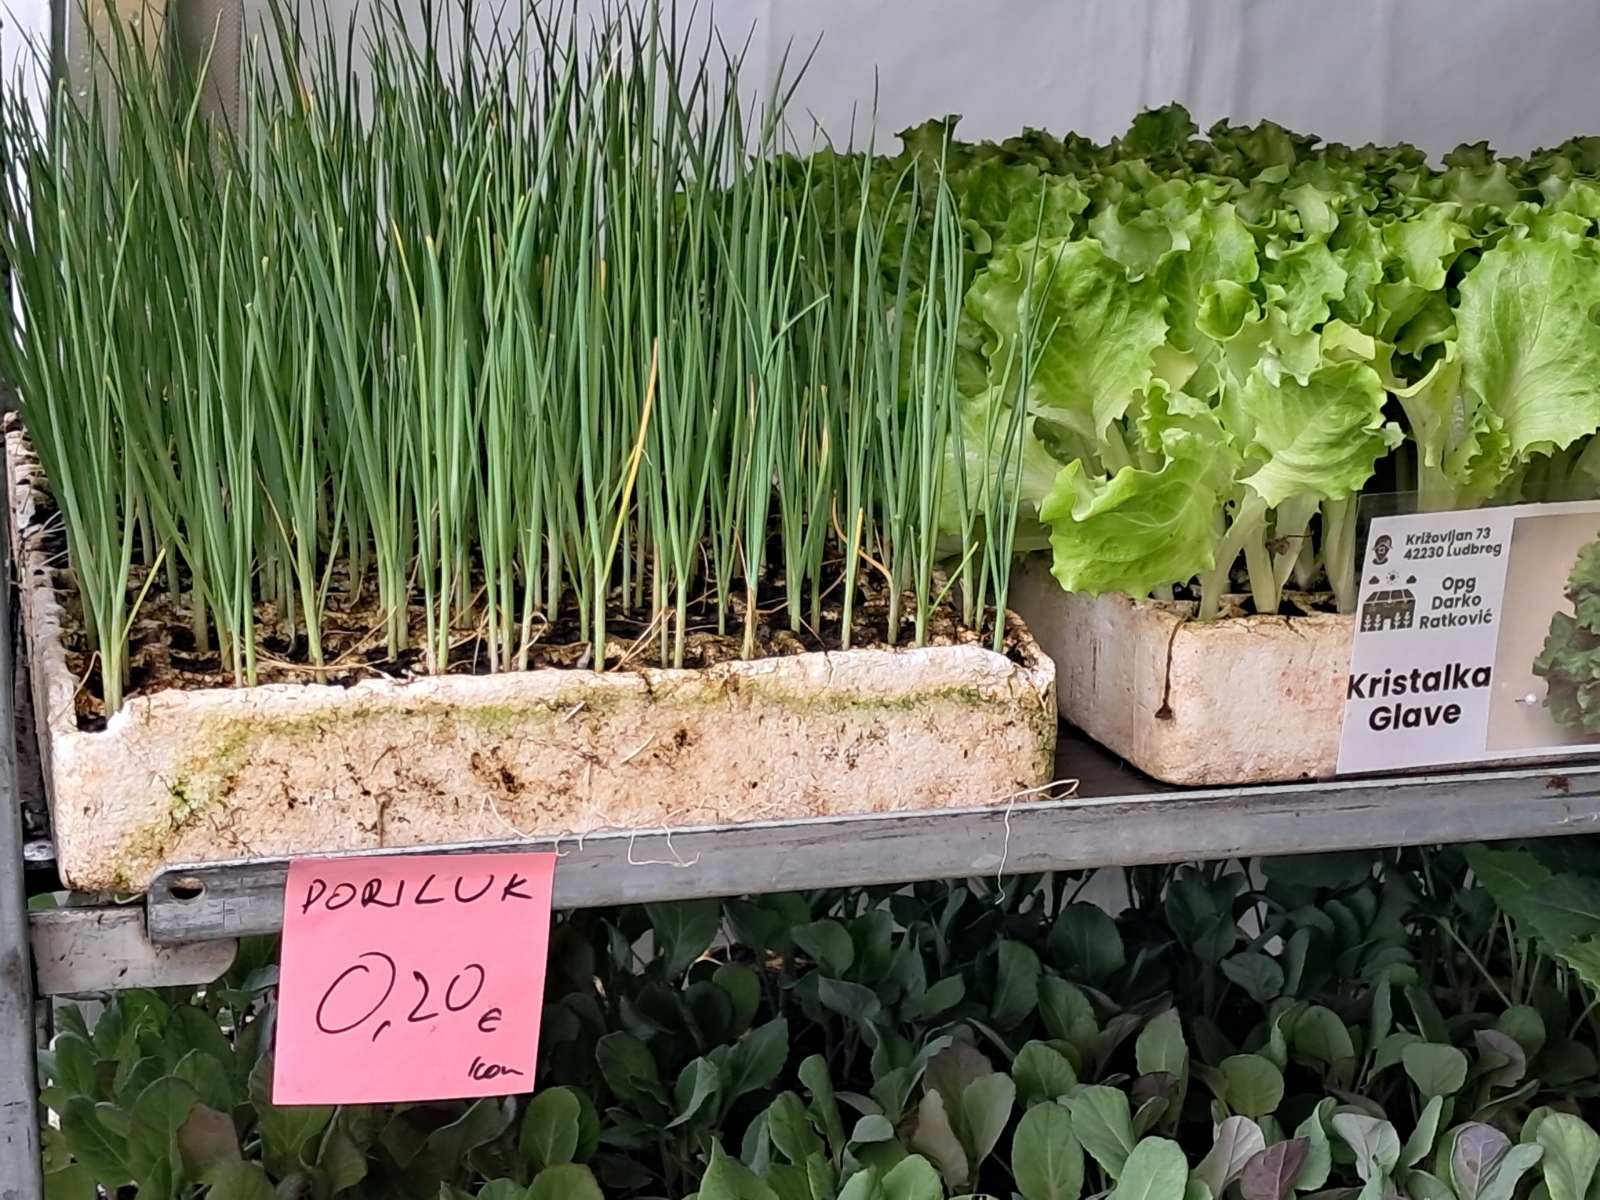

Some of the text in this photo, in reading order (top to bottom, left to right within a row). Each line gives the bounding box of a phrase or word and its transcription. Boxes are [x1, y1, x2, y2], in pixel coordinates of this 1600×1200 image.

[1406, 527, 1491, 547] Križovljan 73
[1403, 542, 1502, 560] 42230 Ludbreg
[1442, 577, 1476, 593] Opg
[1431, 593, 1482, 610] Darko
[1419, 608, 1493, 630] Ratković
[1347, 663, 1492, 700] Kristalka
[1368, 703, 1461, 731] Glave
